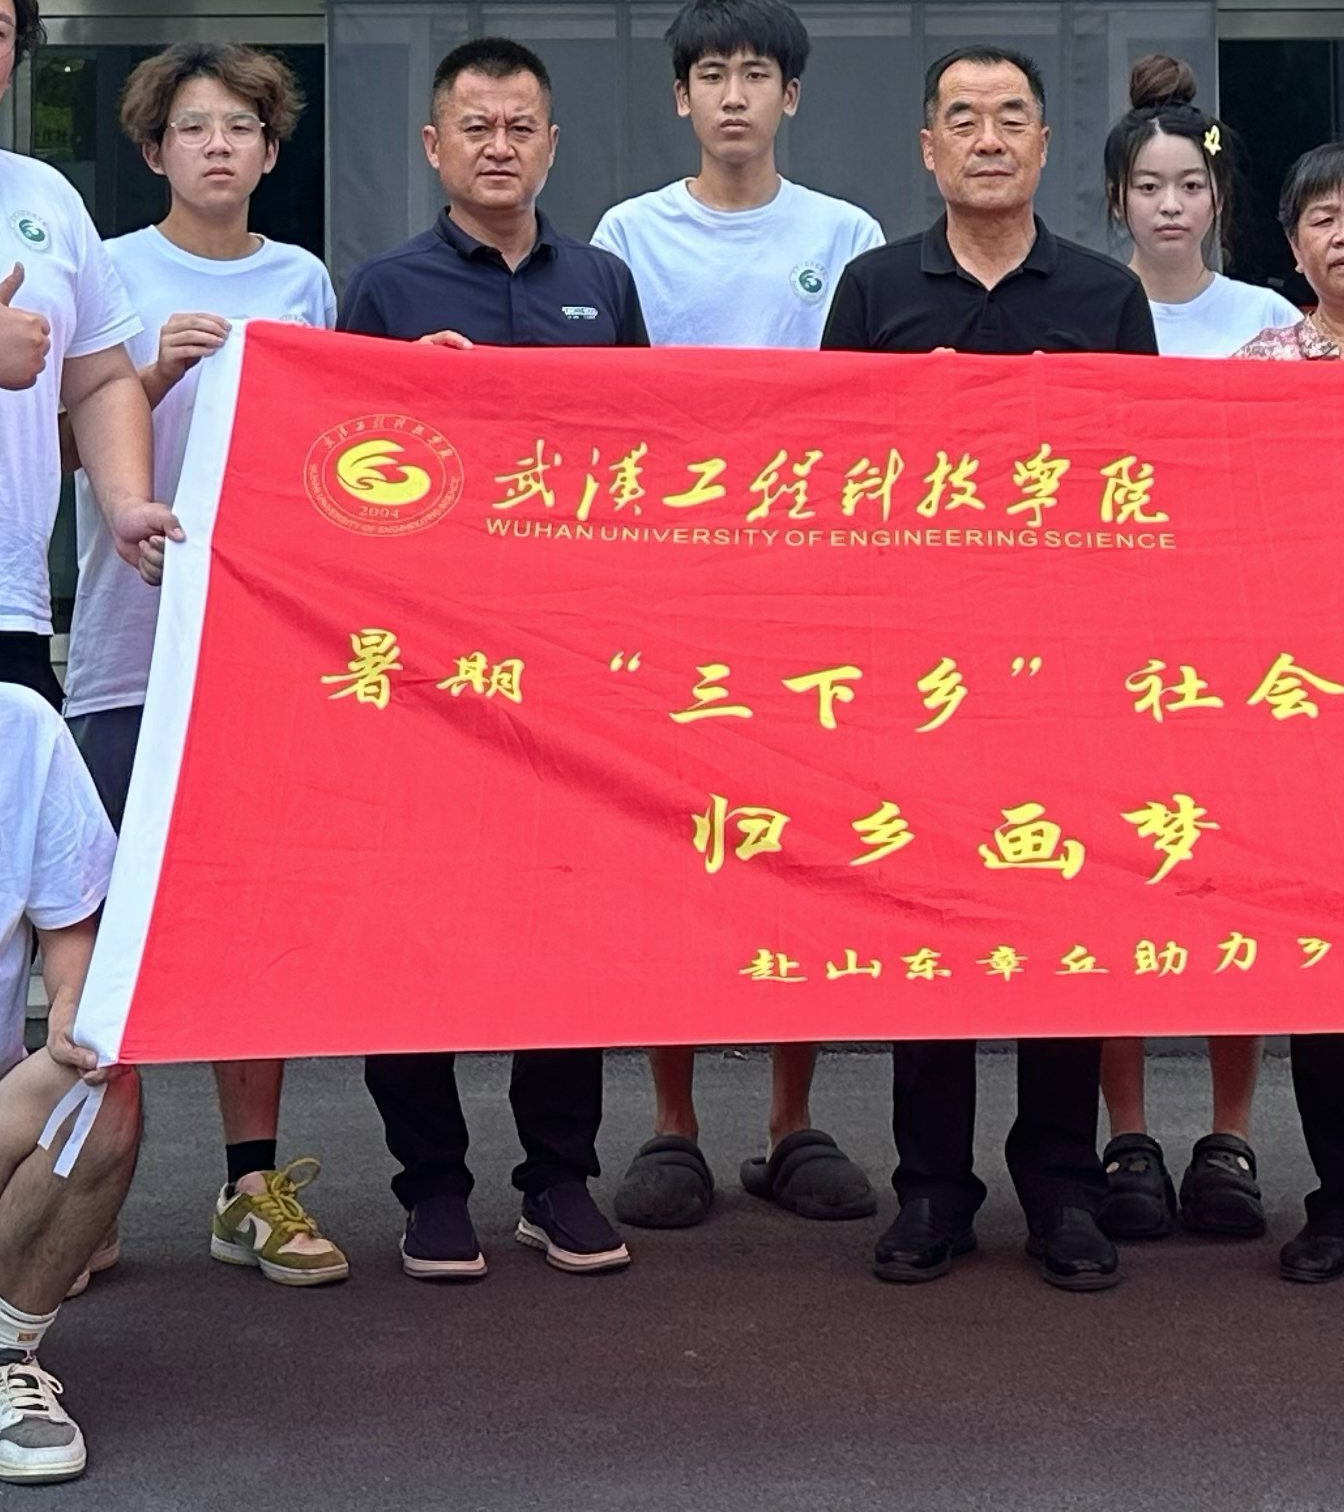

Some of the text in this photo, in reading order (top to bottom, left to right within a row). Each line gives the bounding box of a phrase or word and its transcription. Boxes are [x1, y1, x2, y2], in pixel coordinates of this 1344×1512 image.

[358, 506, 399, 519] 2004
[485, 517, 1177, 549] WUHAN UNIVERSITY OF ENGINEERING SCIENCE
[690, 792, 1220, 885] 归乡画梦
